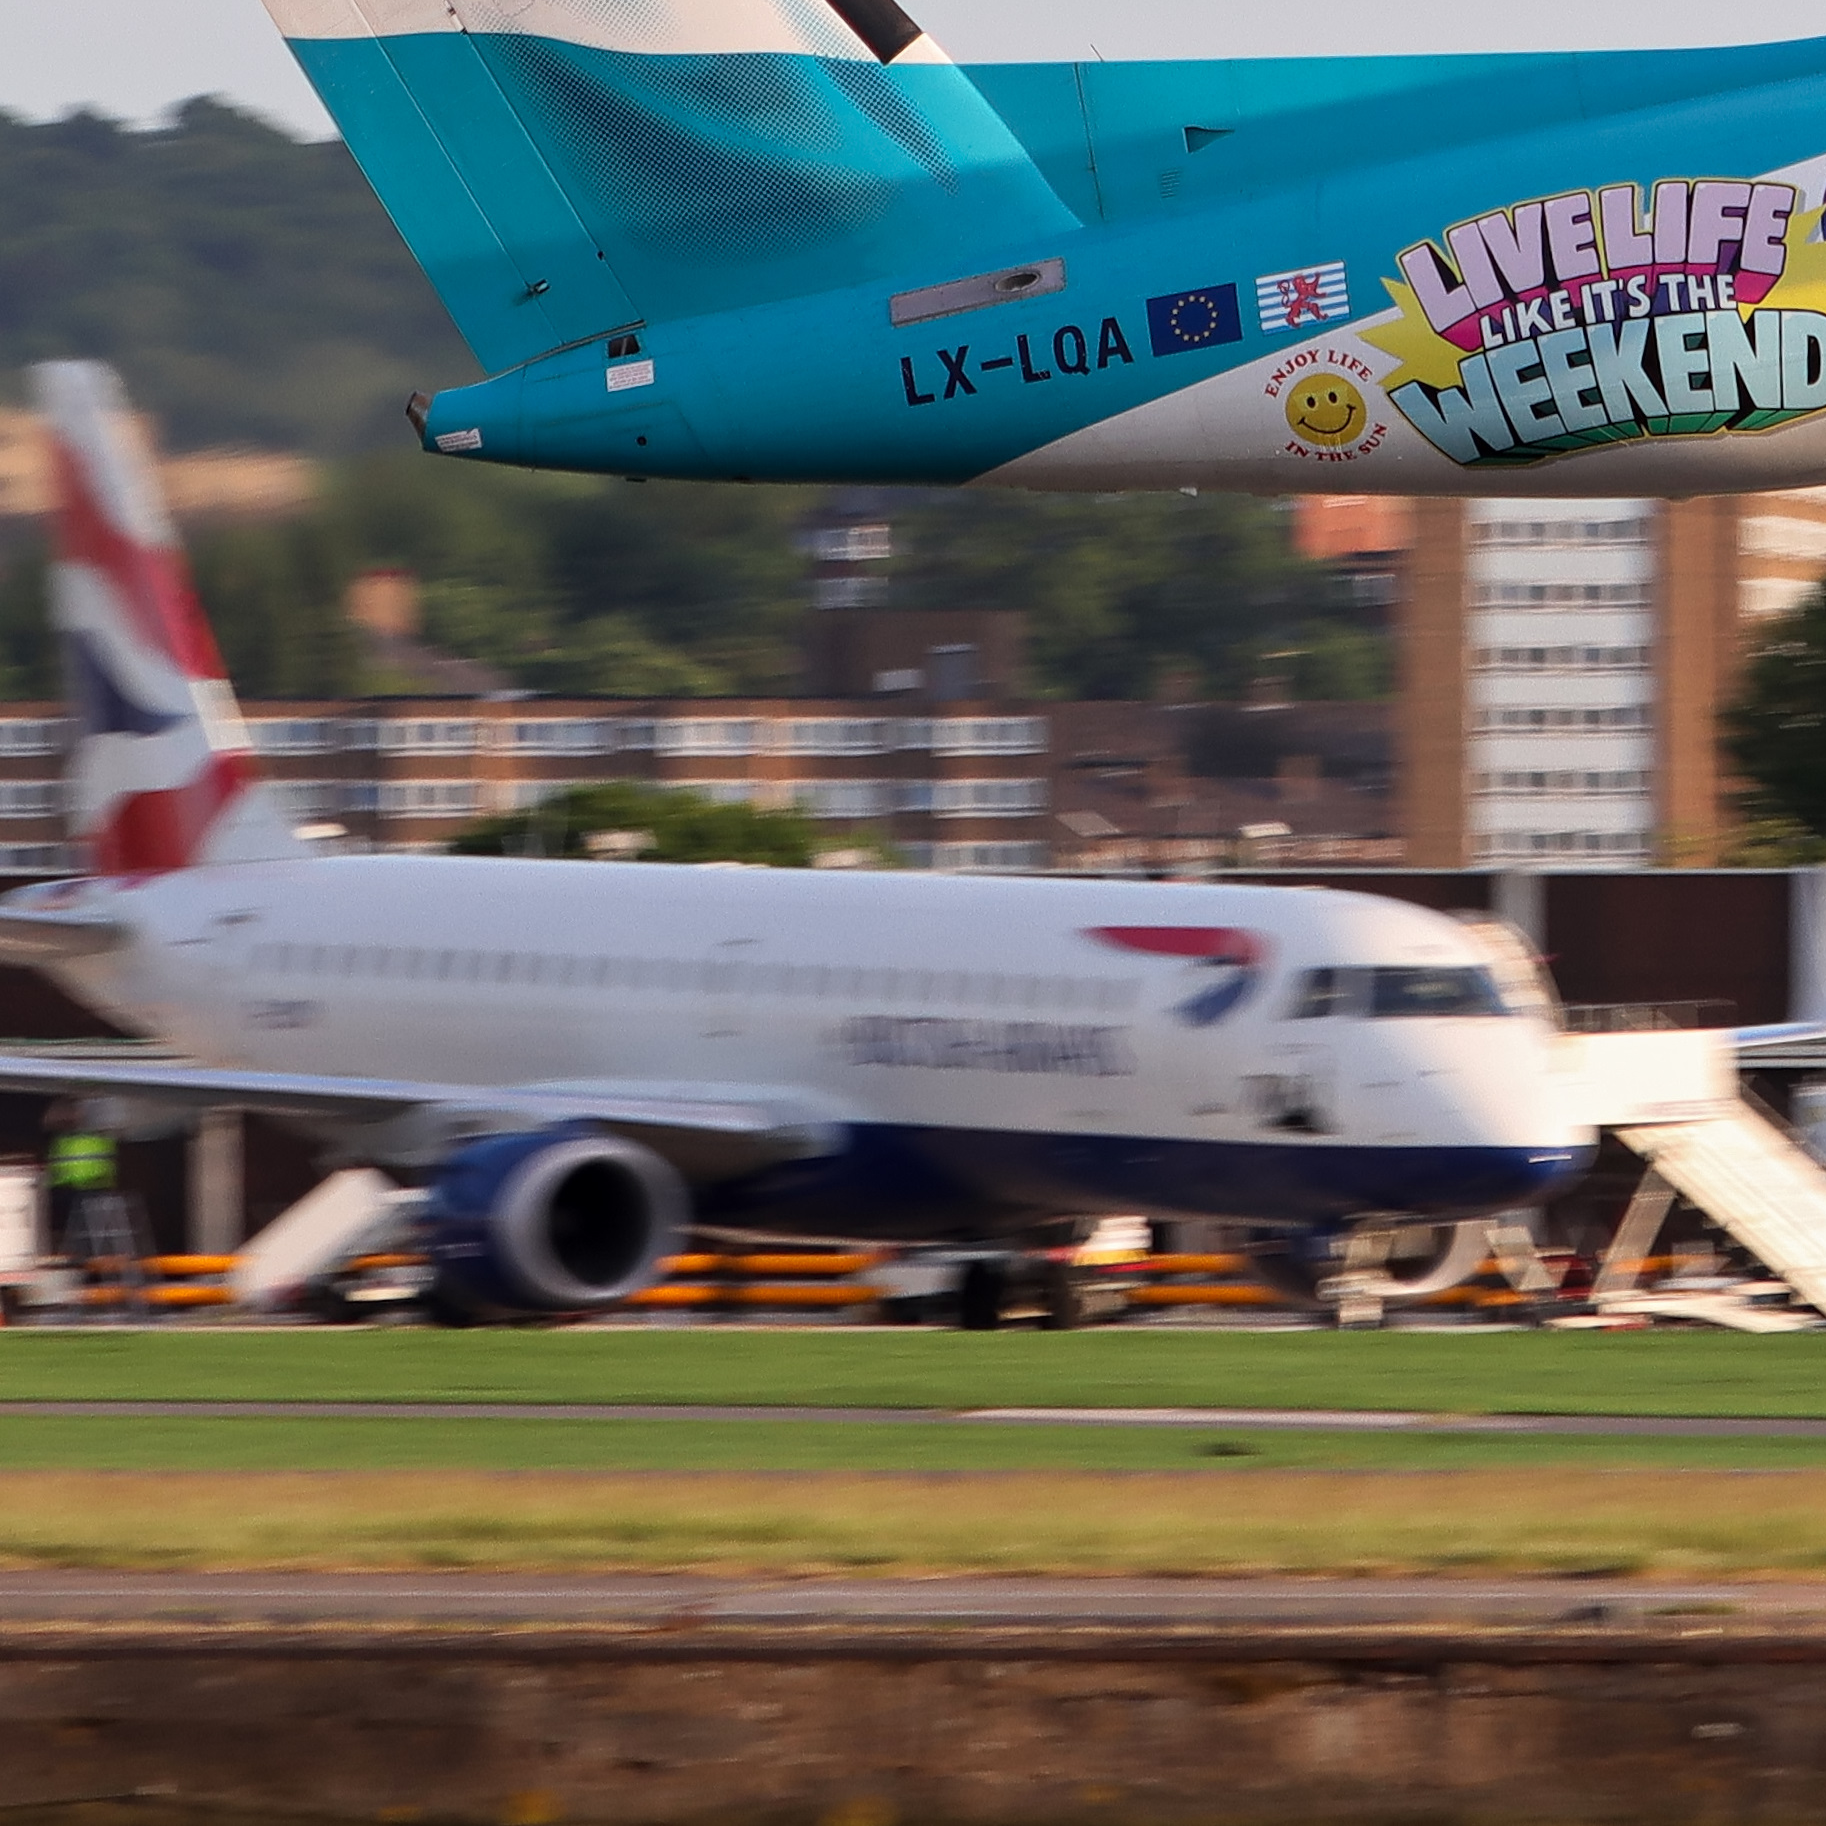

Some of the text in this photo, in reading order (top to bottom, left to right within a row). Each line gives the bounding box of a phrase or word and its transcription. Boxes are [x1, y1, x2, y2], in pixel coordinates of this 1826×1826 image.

[1399, 180, 1797, 339] LIVE LIFE
[1479, 273, 1738, 350] LIKE IT'S THE
[900, 316, 1134, 407] LX-LQA
[1265, 348, 1373, 399] ENJOY LIFE
[1285, 422, 1388, 462] IN THE SUN
